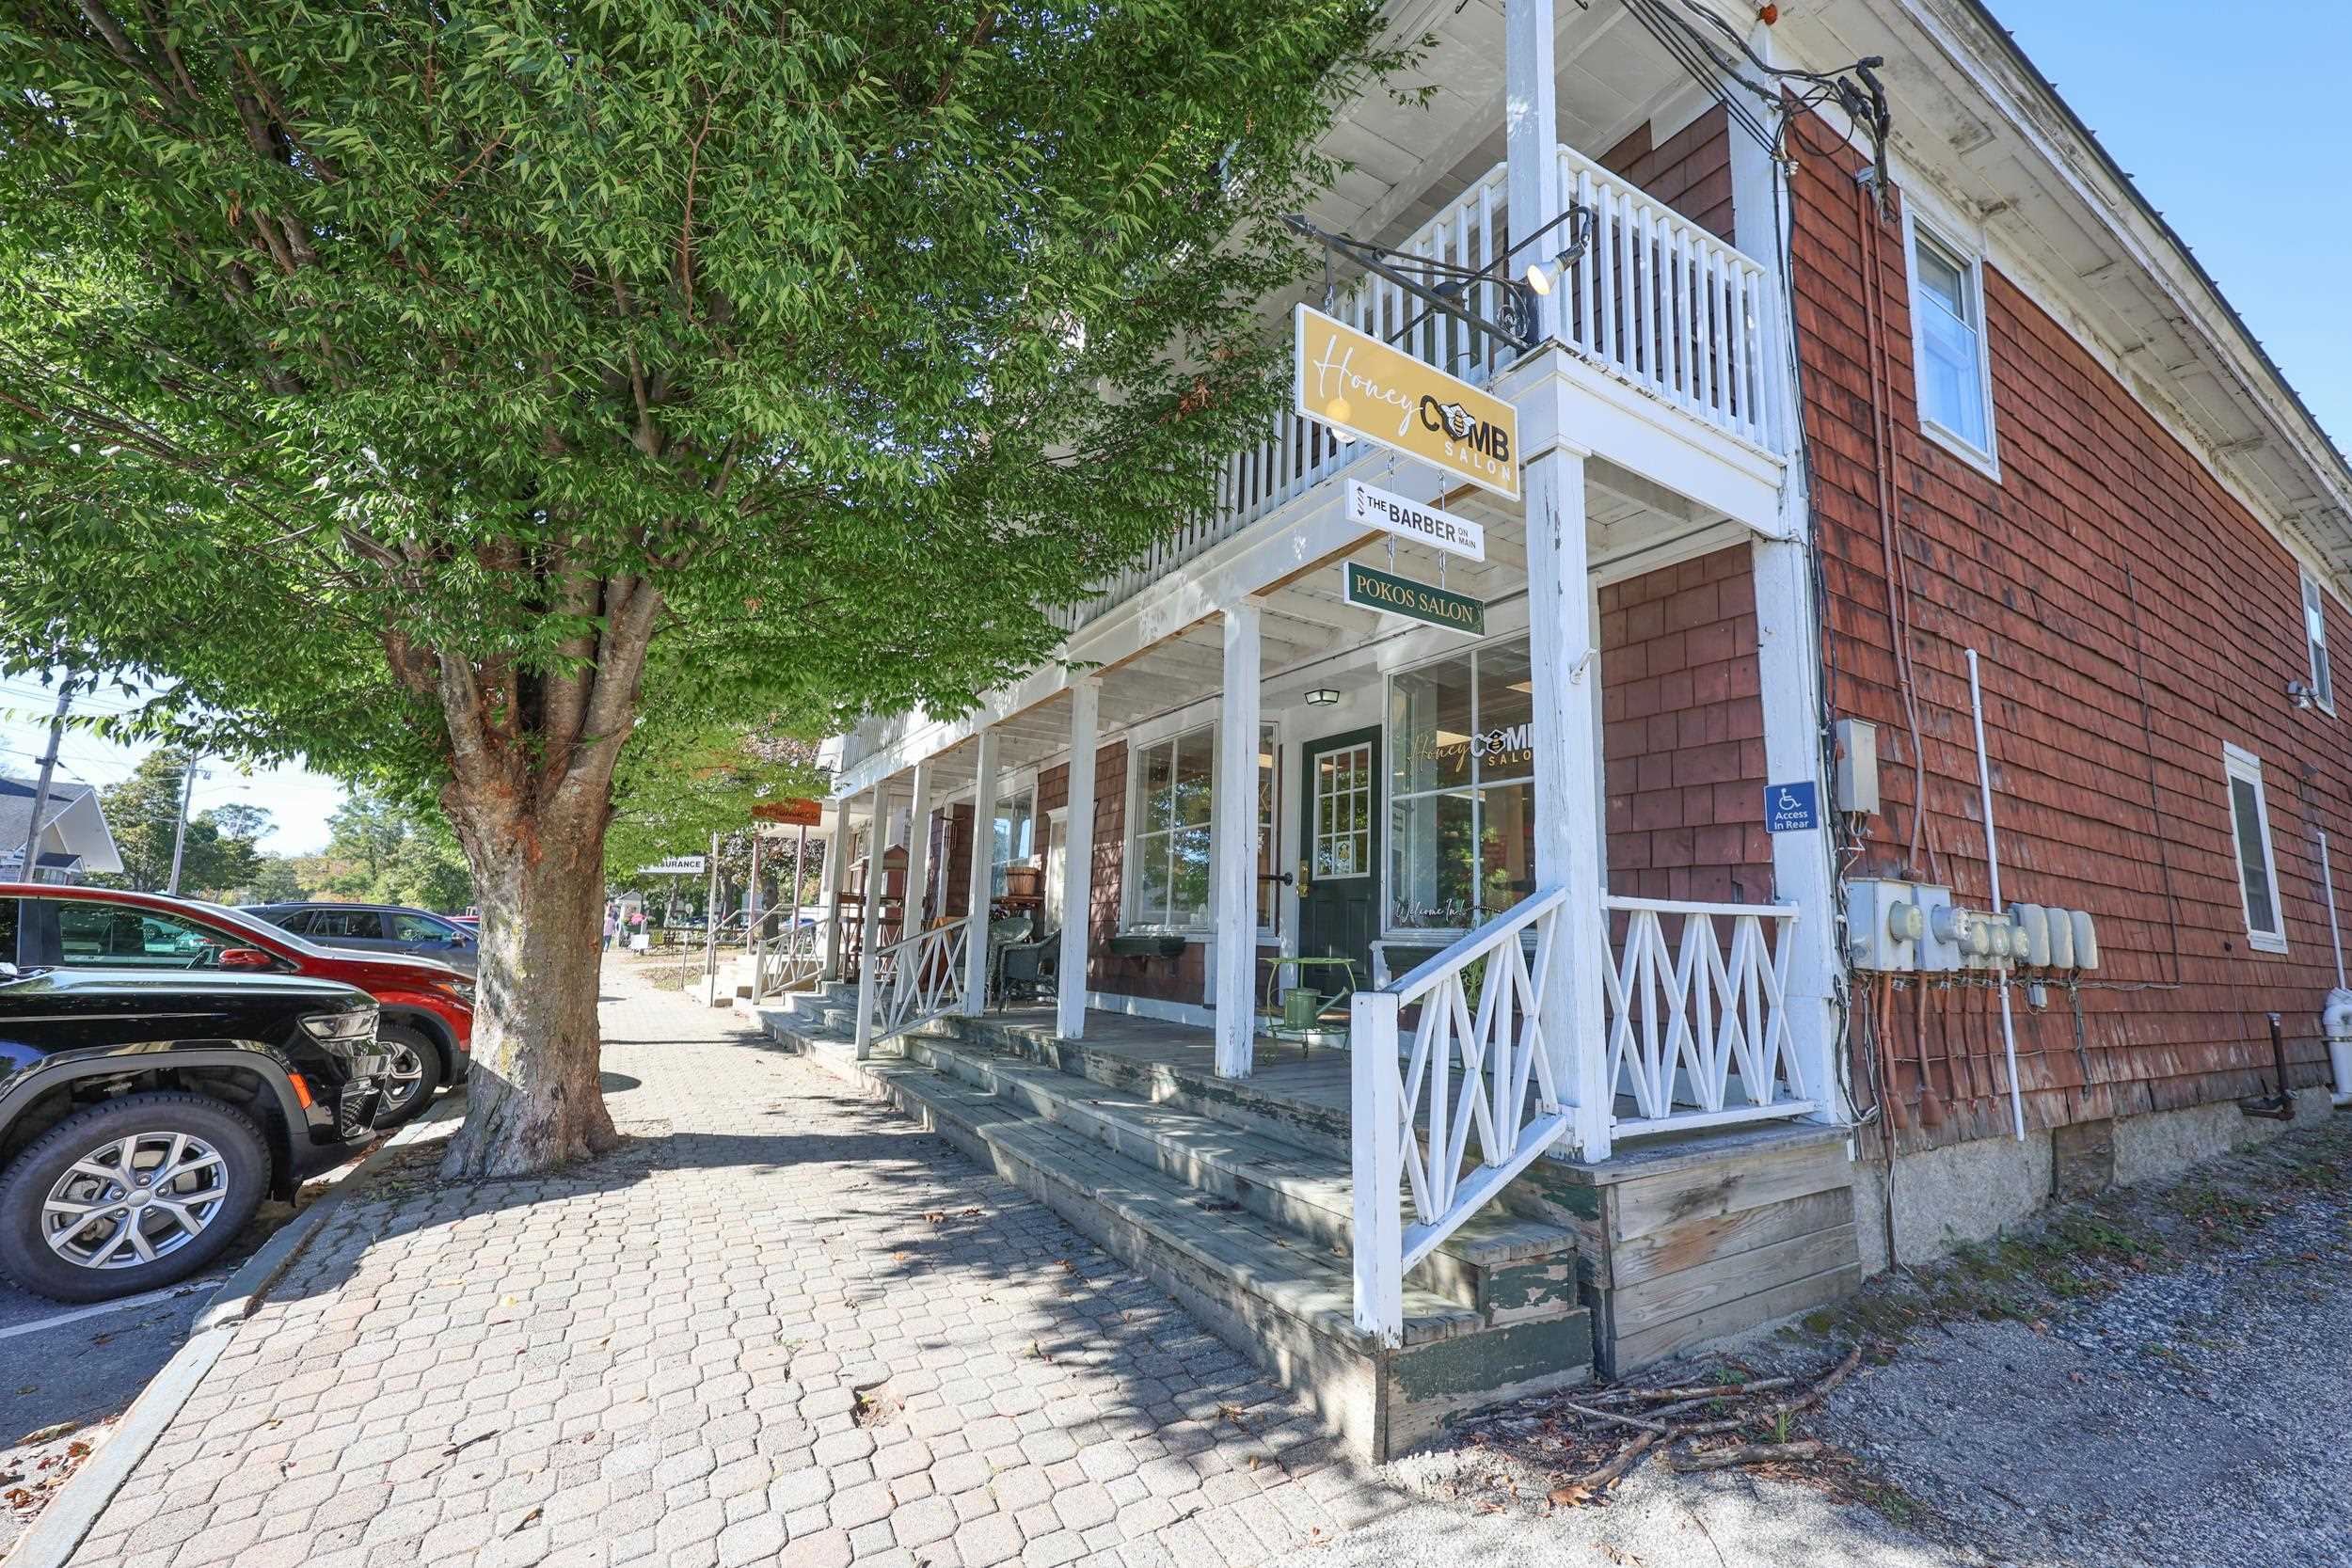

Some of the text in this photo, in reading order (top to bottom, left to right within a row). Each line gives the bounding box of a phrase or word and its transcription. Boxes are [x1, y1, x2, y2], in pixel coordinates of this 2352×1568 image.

[1313, 334, 1422, 437] Honey
[1444, 442, 1511, 482] SALON
[1367, 496, 1455, 543] THE BARBER
[1457, 527, 1469, 537] ON
[1458, 537, 1476, 549] MAIN
[1356, 575, 1472, 624] POKOS SALON
[1488, 750, 1532, 767] SALO
[1775, 811, 1808, 821] Access
[1774, 820, 1809, 831] In Rear
